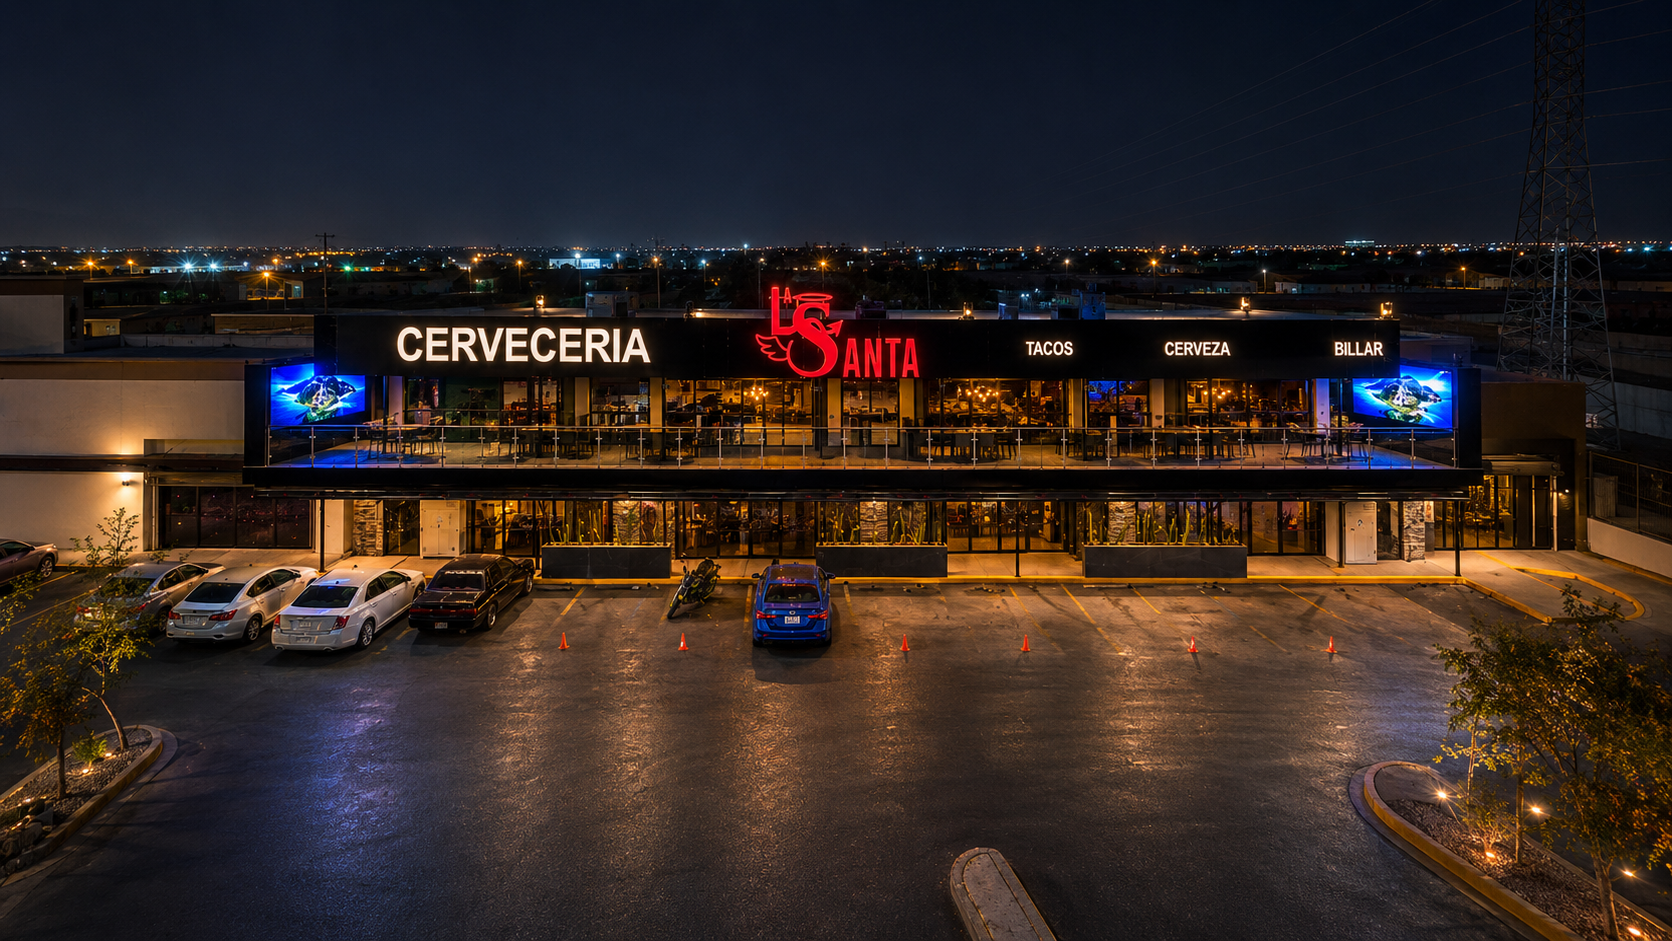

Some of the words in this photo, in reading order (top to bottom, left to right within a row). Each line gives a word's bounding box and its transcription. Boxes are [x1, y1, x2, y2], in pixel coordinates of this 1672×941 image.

[397, 327, 651, 363] CERVECERIA
[787, 302, 920, 378] SANTA
[1026, 341, 1074, 356] TACOS
[1165, 341, 1231, 356] CERVEZA
[1334, 341, 1384, 356] BILLAR
